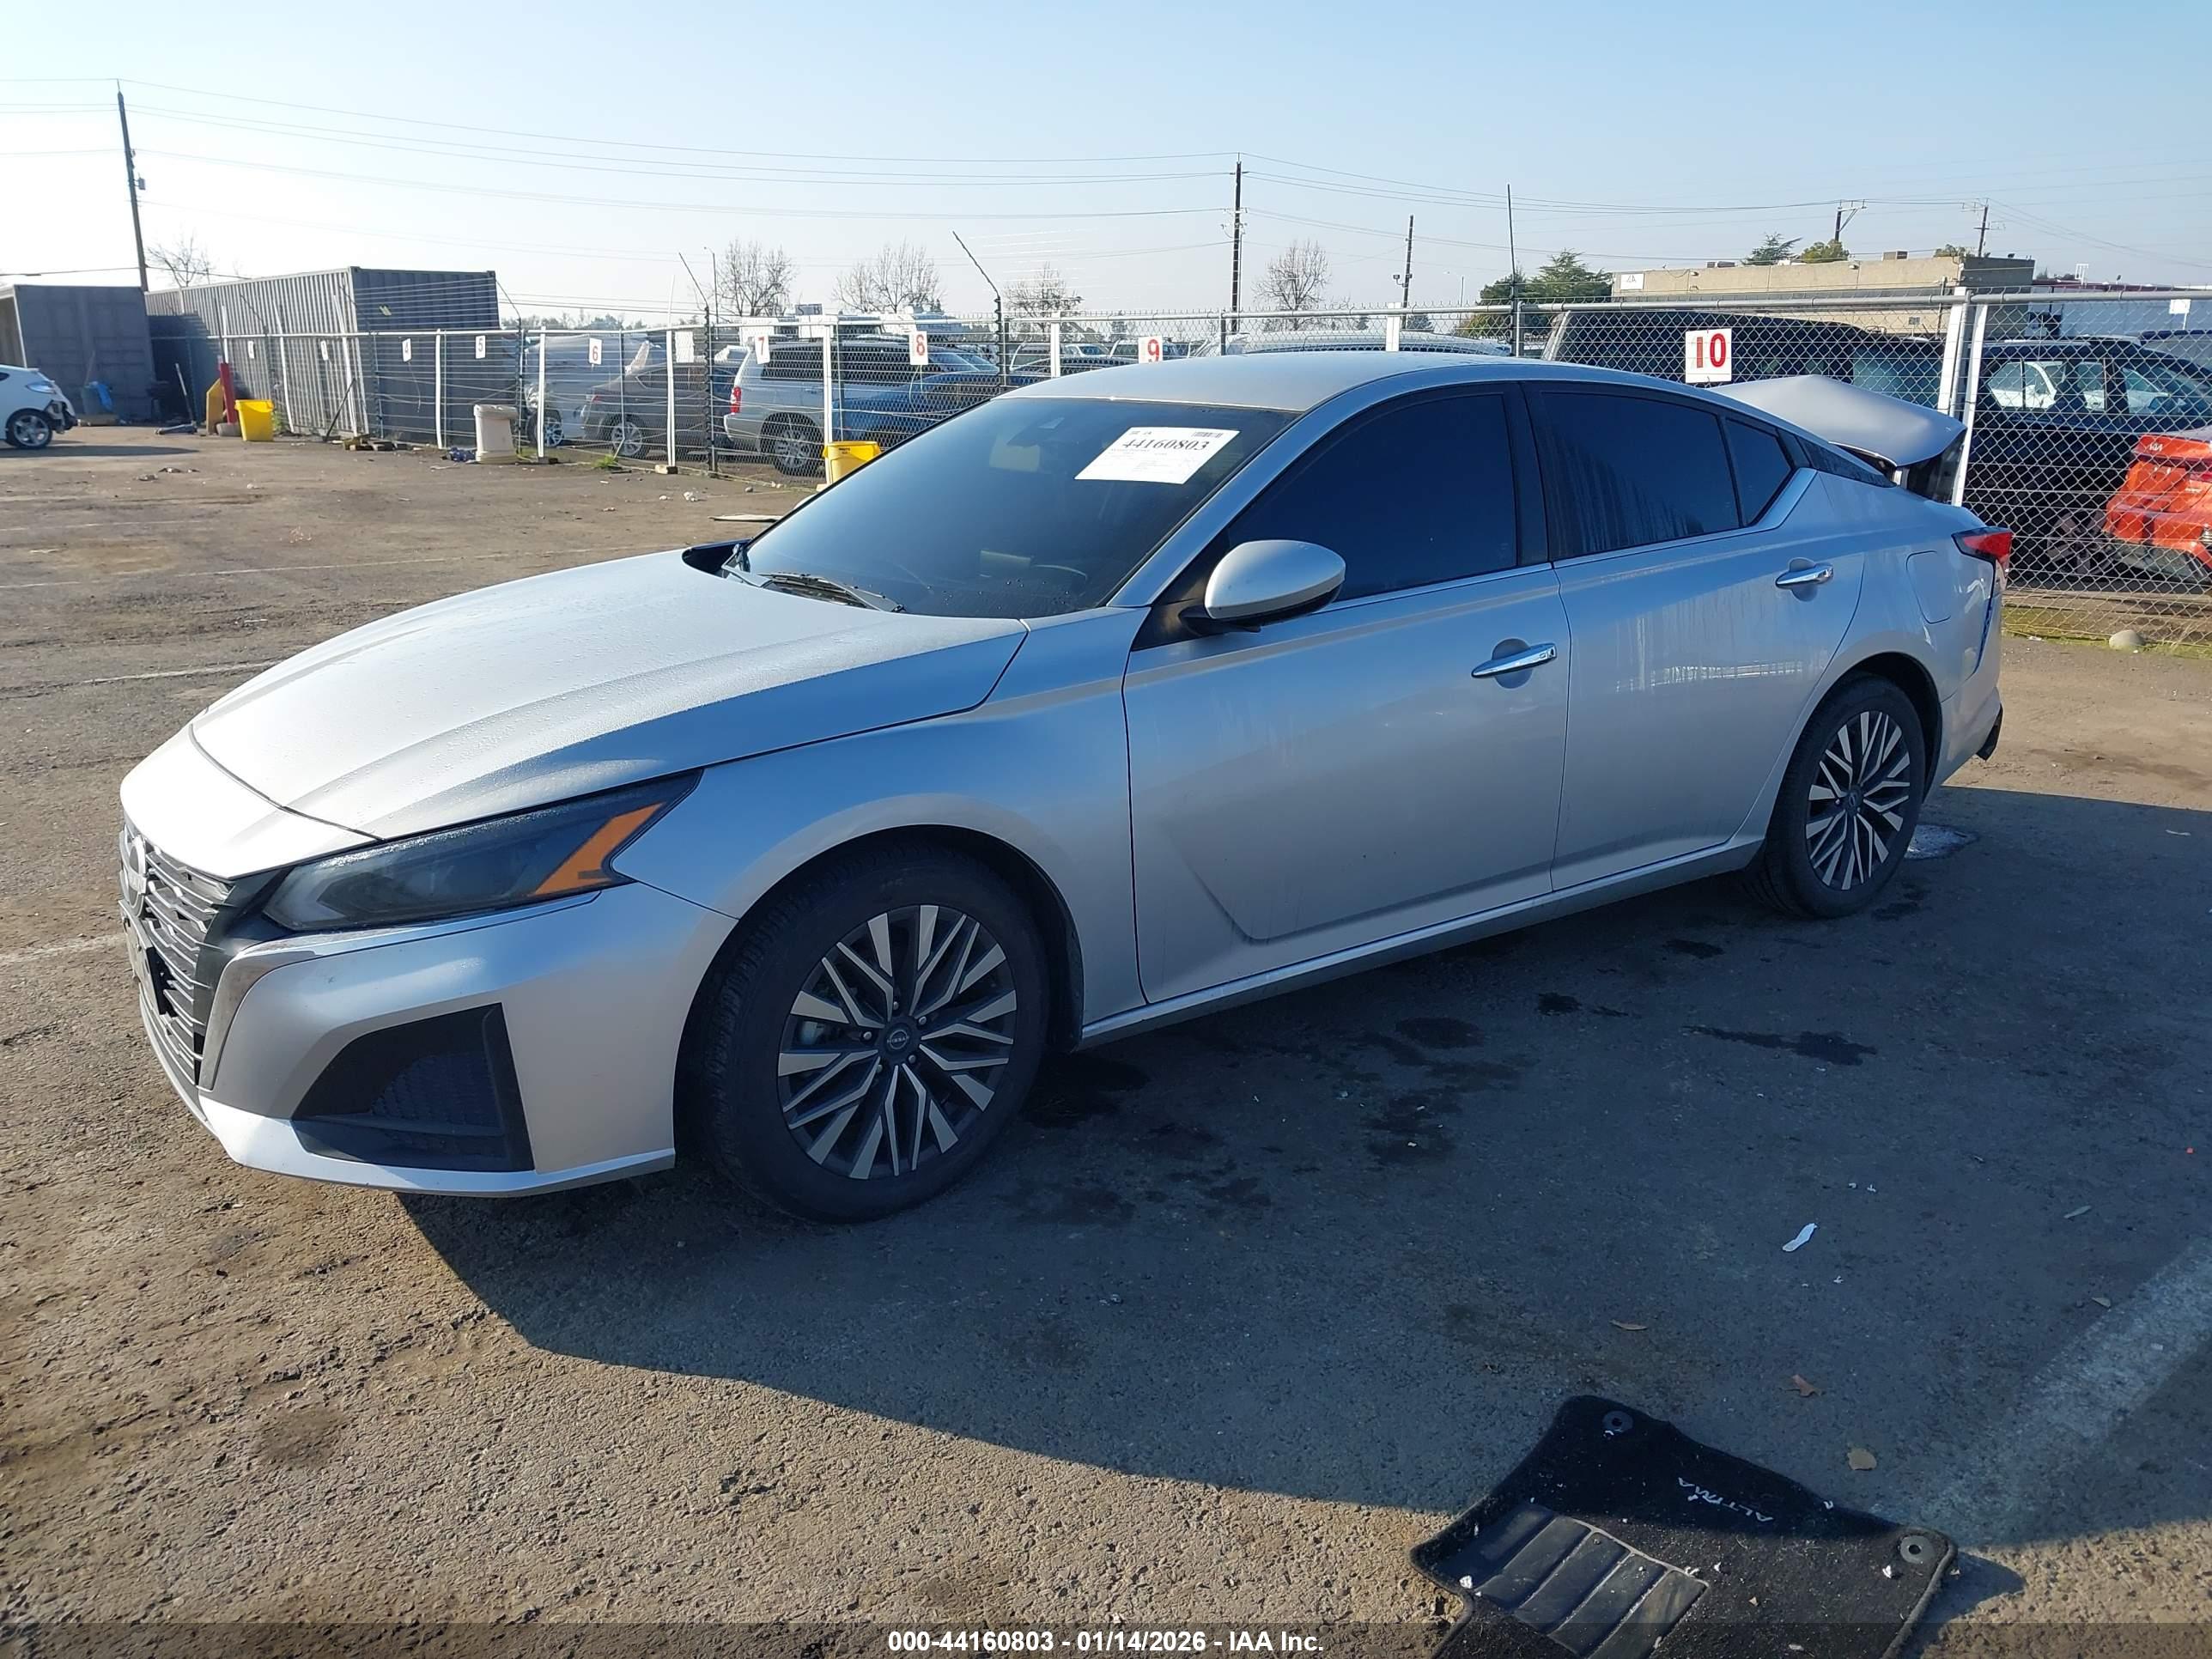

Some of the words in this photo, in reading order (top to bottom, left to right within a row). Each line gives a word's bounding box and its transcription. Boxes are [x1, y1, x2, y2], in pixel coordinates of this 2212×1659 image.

[478, 337, 483, 352] 5
[592, 345, 599, 362] 6
[757, 336, 765, 356] 7
[916, 334, 926, 356] 8
[1147, 338, 1160, 363] 9
[1696, 333, 1727, 368] 10
[1122, 439, 1210, 451] 44160803
[1678, 1476, 1774, 1522] ALTIMA
